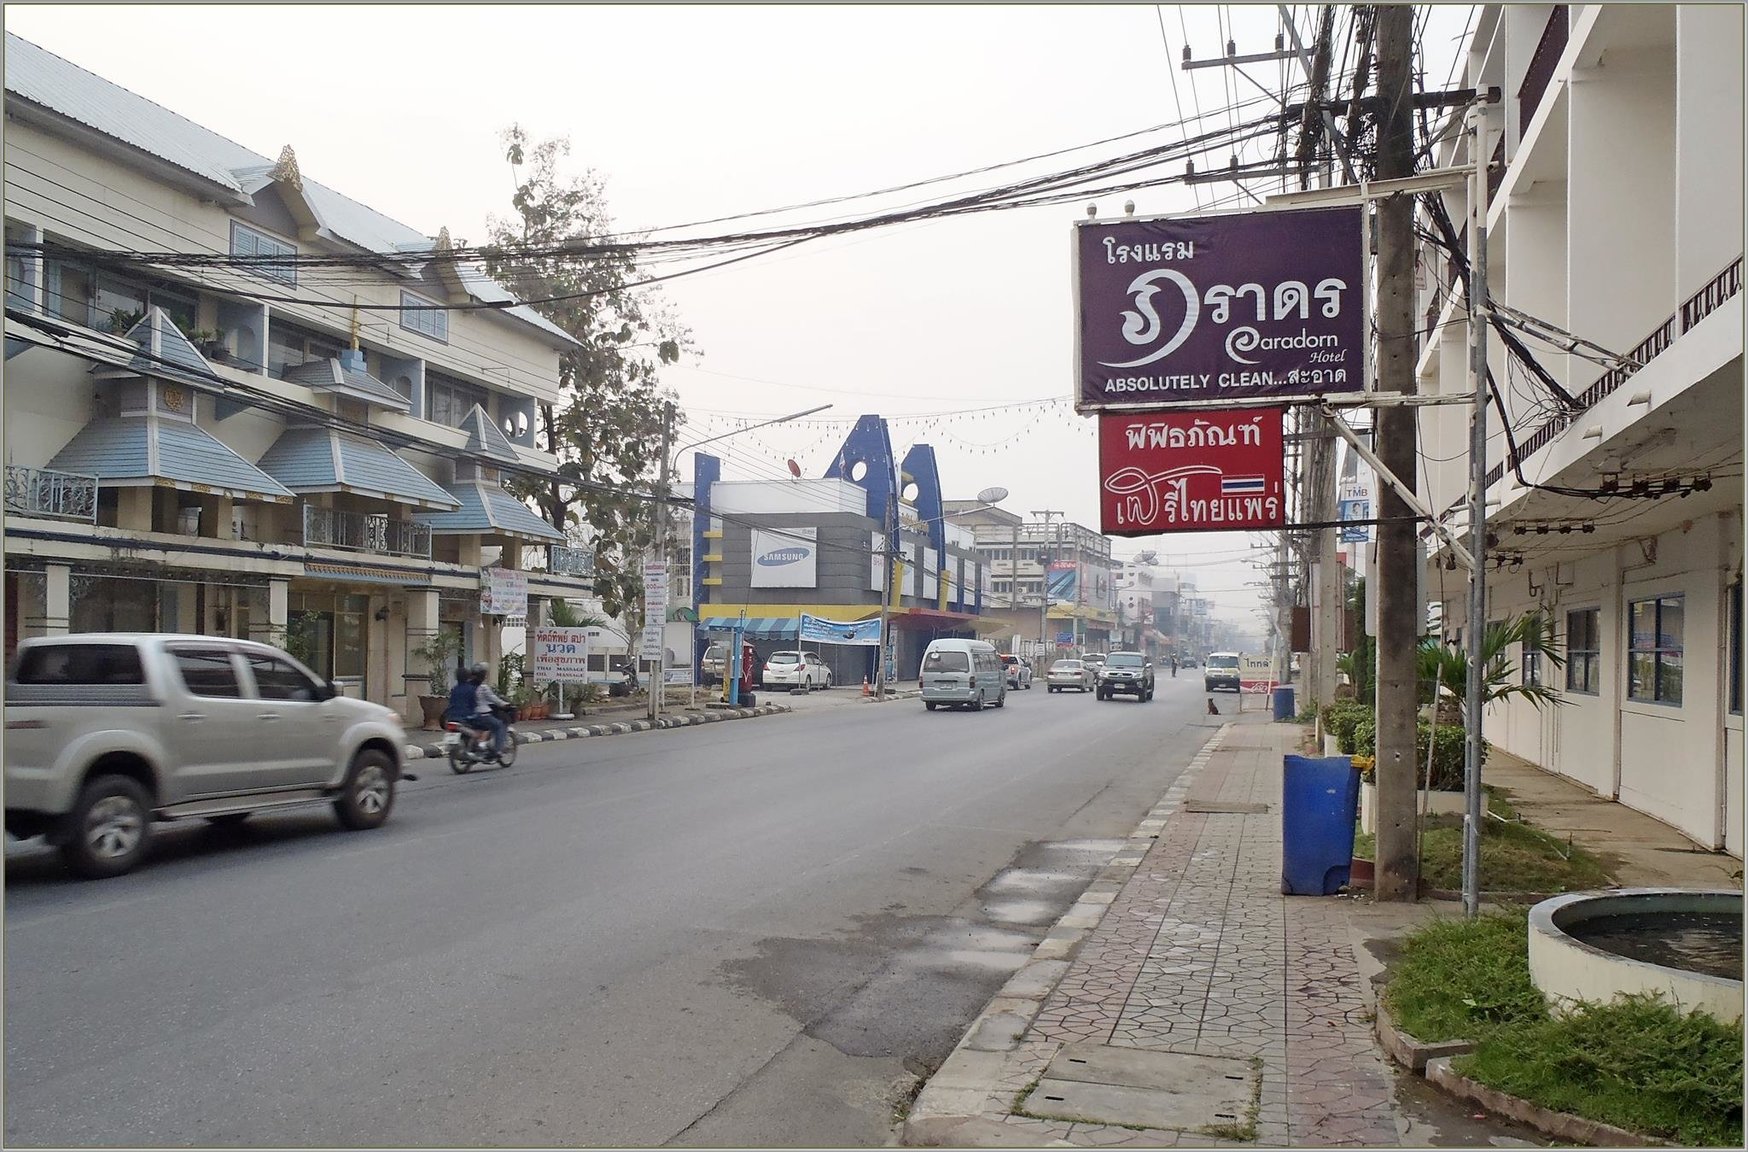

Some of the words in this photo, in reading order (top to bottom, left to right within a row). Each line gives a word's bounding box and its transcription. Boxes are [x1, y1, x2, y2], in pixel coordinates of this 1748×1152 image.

[1102, 236, 1194, 264] โรงแรม
[1308, 349, 1348, 365] Hotel
[1104, 374, 1210, 393] ABSOLUTELY
[1125, 415, 1263, 451] พิพิธภัณฑ์
[1345, 487, 1368, 497] TMB
[763, 552, 804, 561] SAMSUNG
[570, 633, 586, 643] สปา
[546, 643, 576, 653] นวด
[536, 652, 586, 666] เพื่อสุขภาพ
